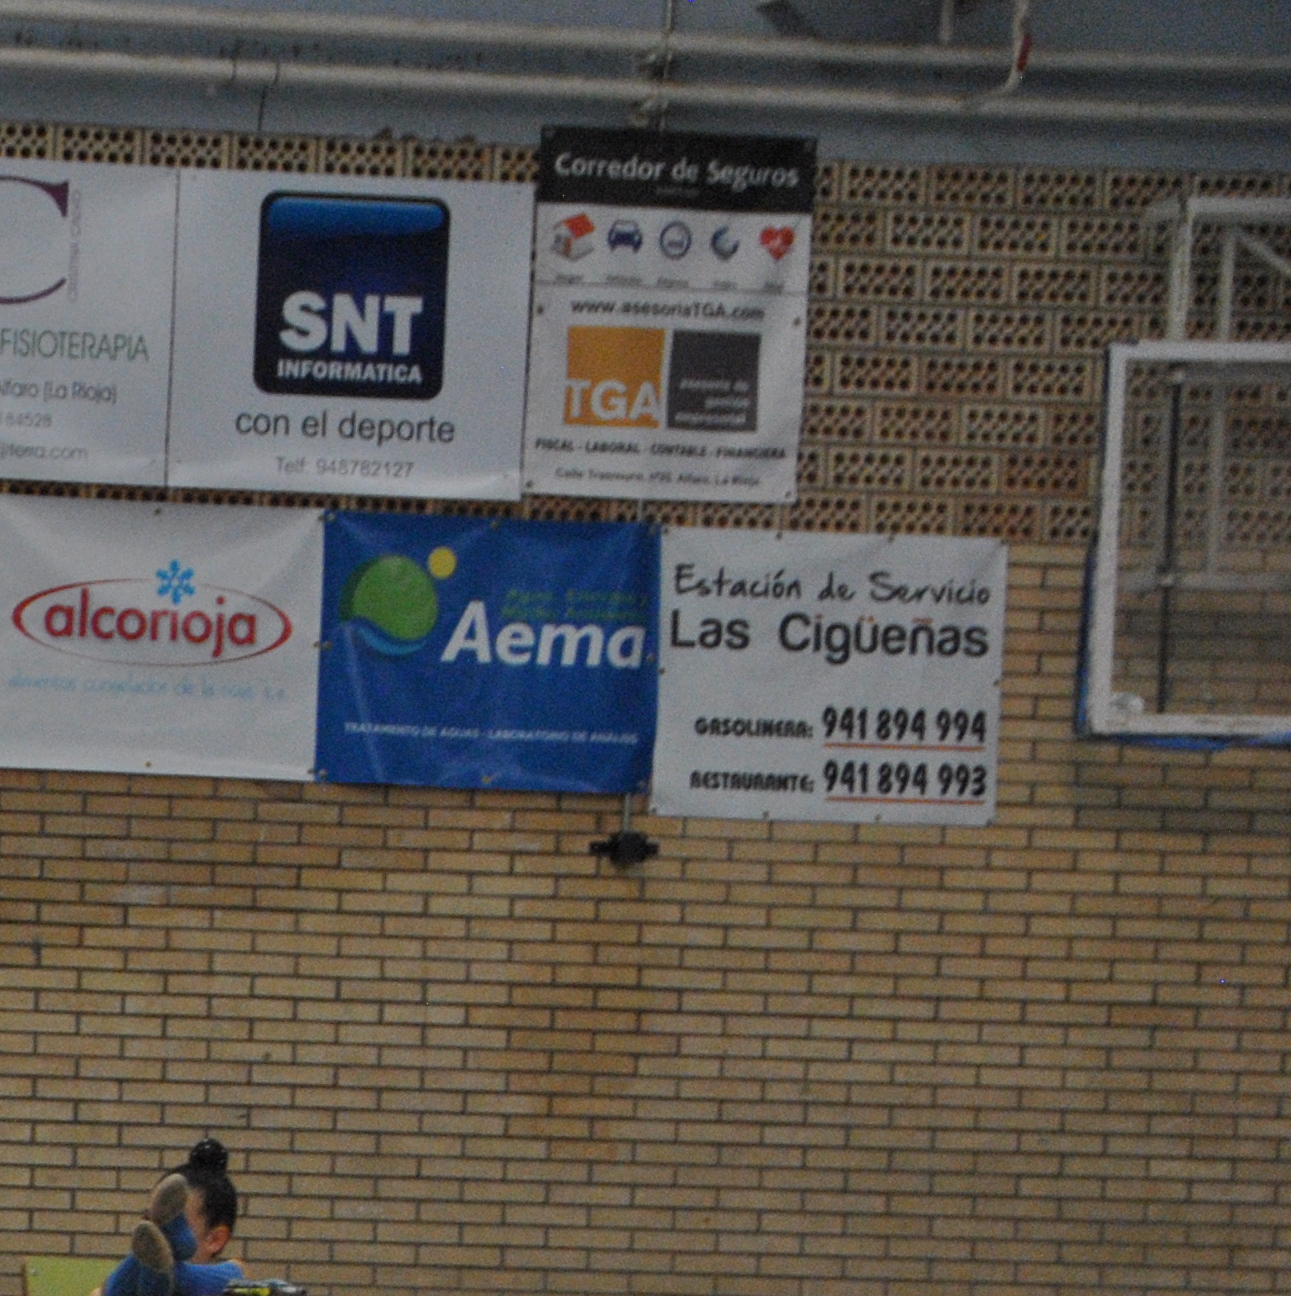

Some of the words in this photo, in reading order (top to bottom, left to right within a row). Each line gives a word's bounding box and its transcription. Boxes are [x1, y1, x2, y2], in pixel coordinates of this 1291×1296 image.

[553, 152, 665, 181] Corredor
[671, 156, 699, 182] de
[705, 159, 801, 193] Seguros
[278, 289, 424, 357] SNT
[0, 327, 150, 363] FISIOTERAPIA
[277, 358, 424, 386] INFORMATICA
[566, 378, 662, 424] TGA
[235, 411, 291, 438] con
[301, 410, 328, 439] el
[337, 410, 456, 447] deporte
[674, 562, 802, 601] Estación
[817, 570, 857, 603] de
[868, 570, 992, 606] Servicio
[43, 586, 257, 659] alcorioja
[439, 598, 647, 670] Aema
[669, 608, 752, 652] Las
[778, 611, 990, 666] Cigüeñas
[694, 717, 815, 740] GASOLINERA:
[822, 705, 868, 740] 941
[876, 707, 927, 742] 894
[935, 708, 988, 744] 994
[689, 770, 815, 793] RESTAURANTE:
[823, 759, 869, 794] 941
[877, 762, 928, 797] 894
[936, 762, 988, 798] 993
